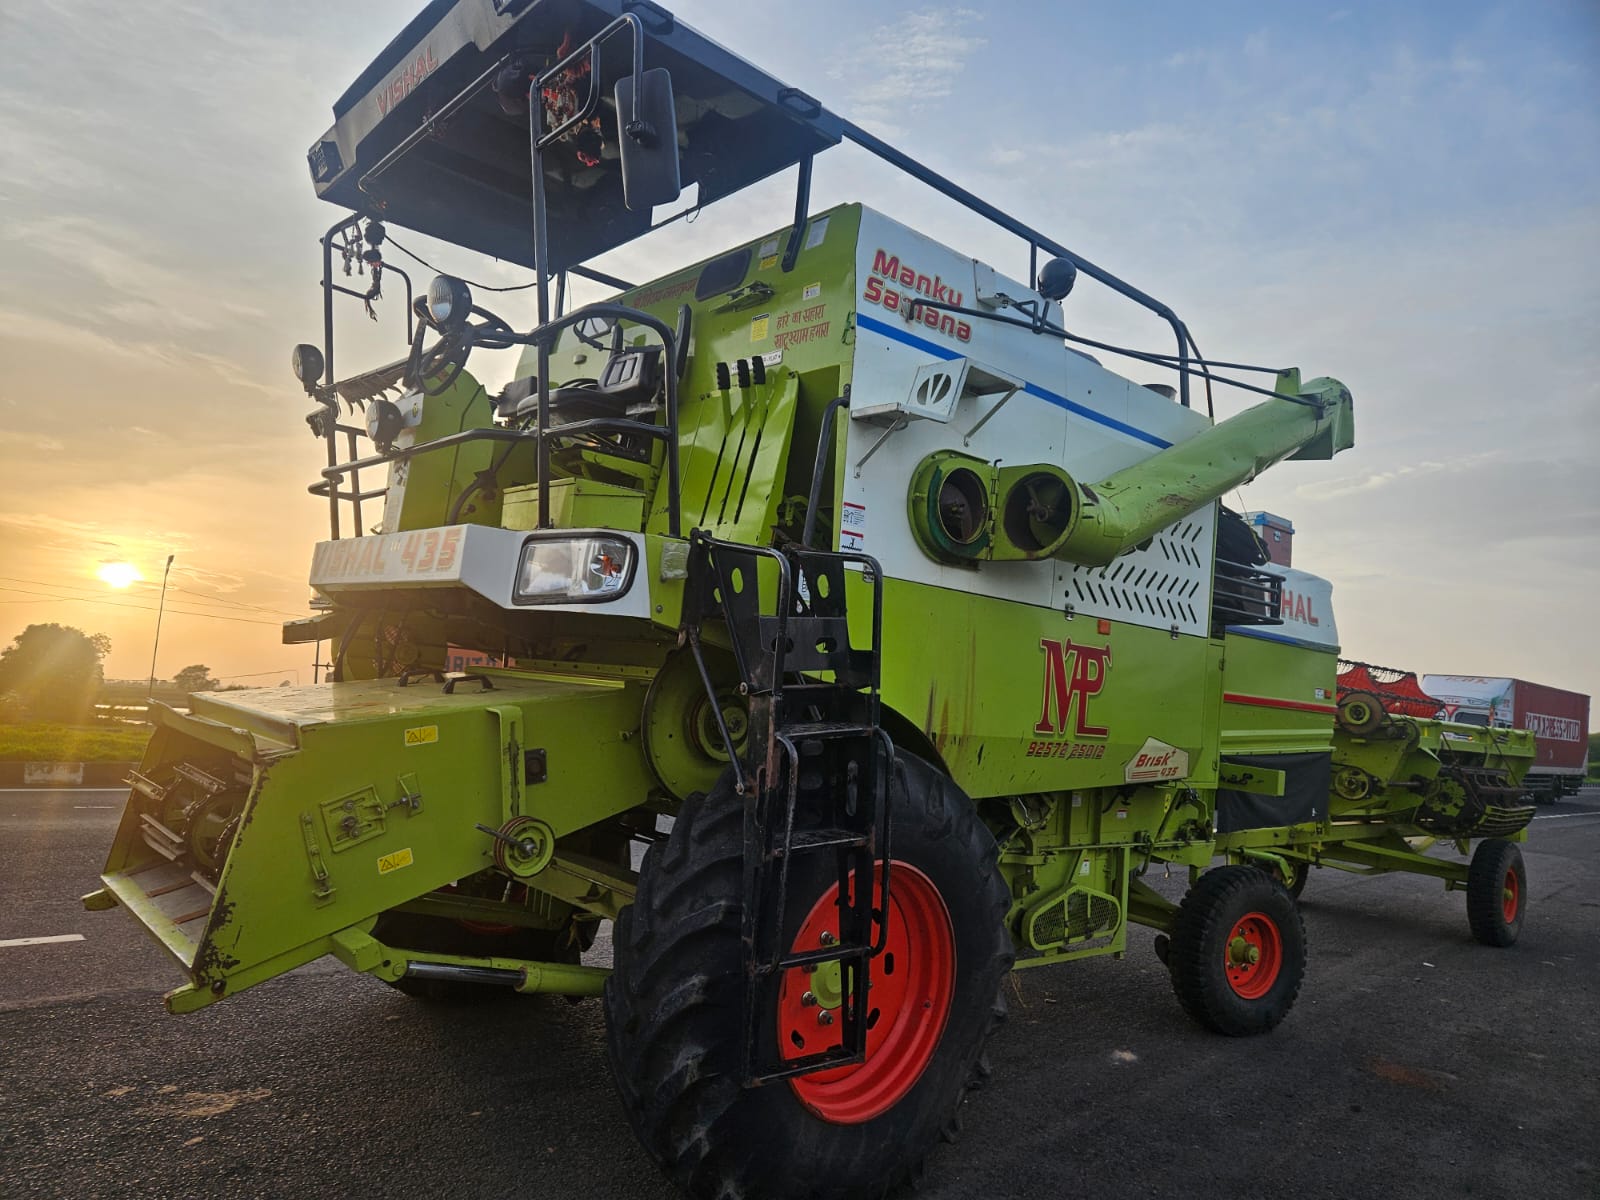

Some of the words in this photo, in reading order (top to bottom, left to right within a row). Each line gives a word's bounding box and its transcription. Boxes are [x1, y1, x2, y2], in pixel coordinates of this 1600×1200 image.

[375, 45, 439, 115] VISHAL
[872, 248, 963, 308] Manku
[401, 528, 462, 575] 435
[1160, 766, 1179, 777] 435
